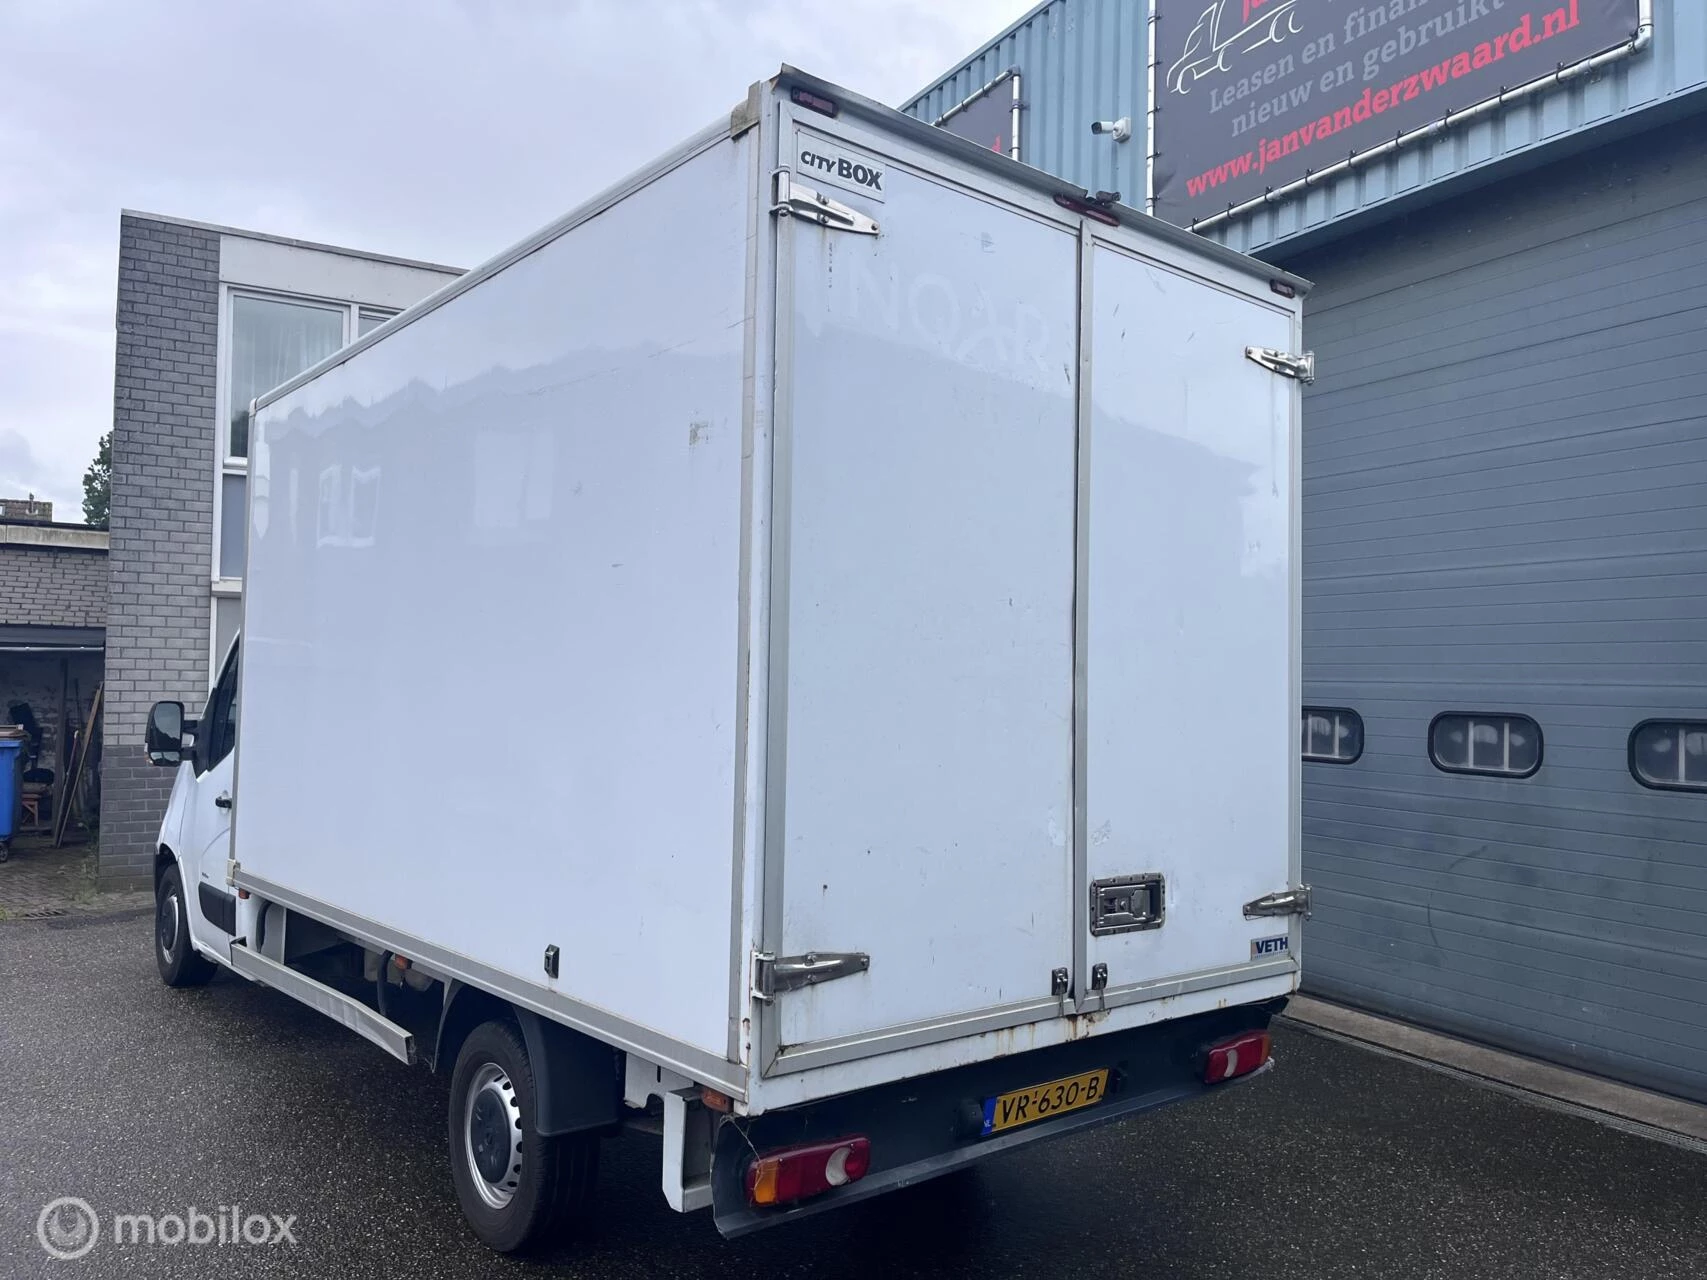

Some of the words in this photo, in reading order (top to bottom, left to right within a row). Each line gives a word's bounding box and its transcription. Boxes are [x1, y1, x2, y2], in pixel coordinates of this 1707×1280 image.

[1186, 0, 1580, 197] www.janvanderzwaard.nl
[1209, 54, 1295, 113] Leasen
[1302, 32, 1335, 64] en
[1231, 80, 1312, 137] nieuw
[1320, 60, 1354, 92] en
[1255, 937, 1288, 954] VETH
[1002, 1076, 1100, 1124] VR-630-B
